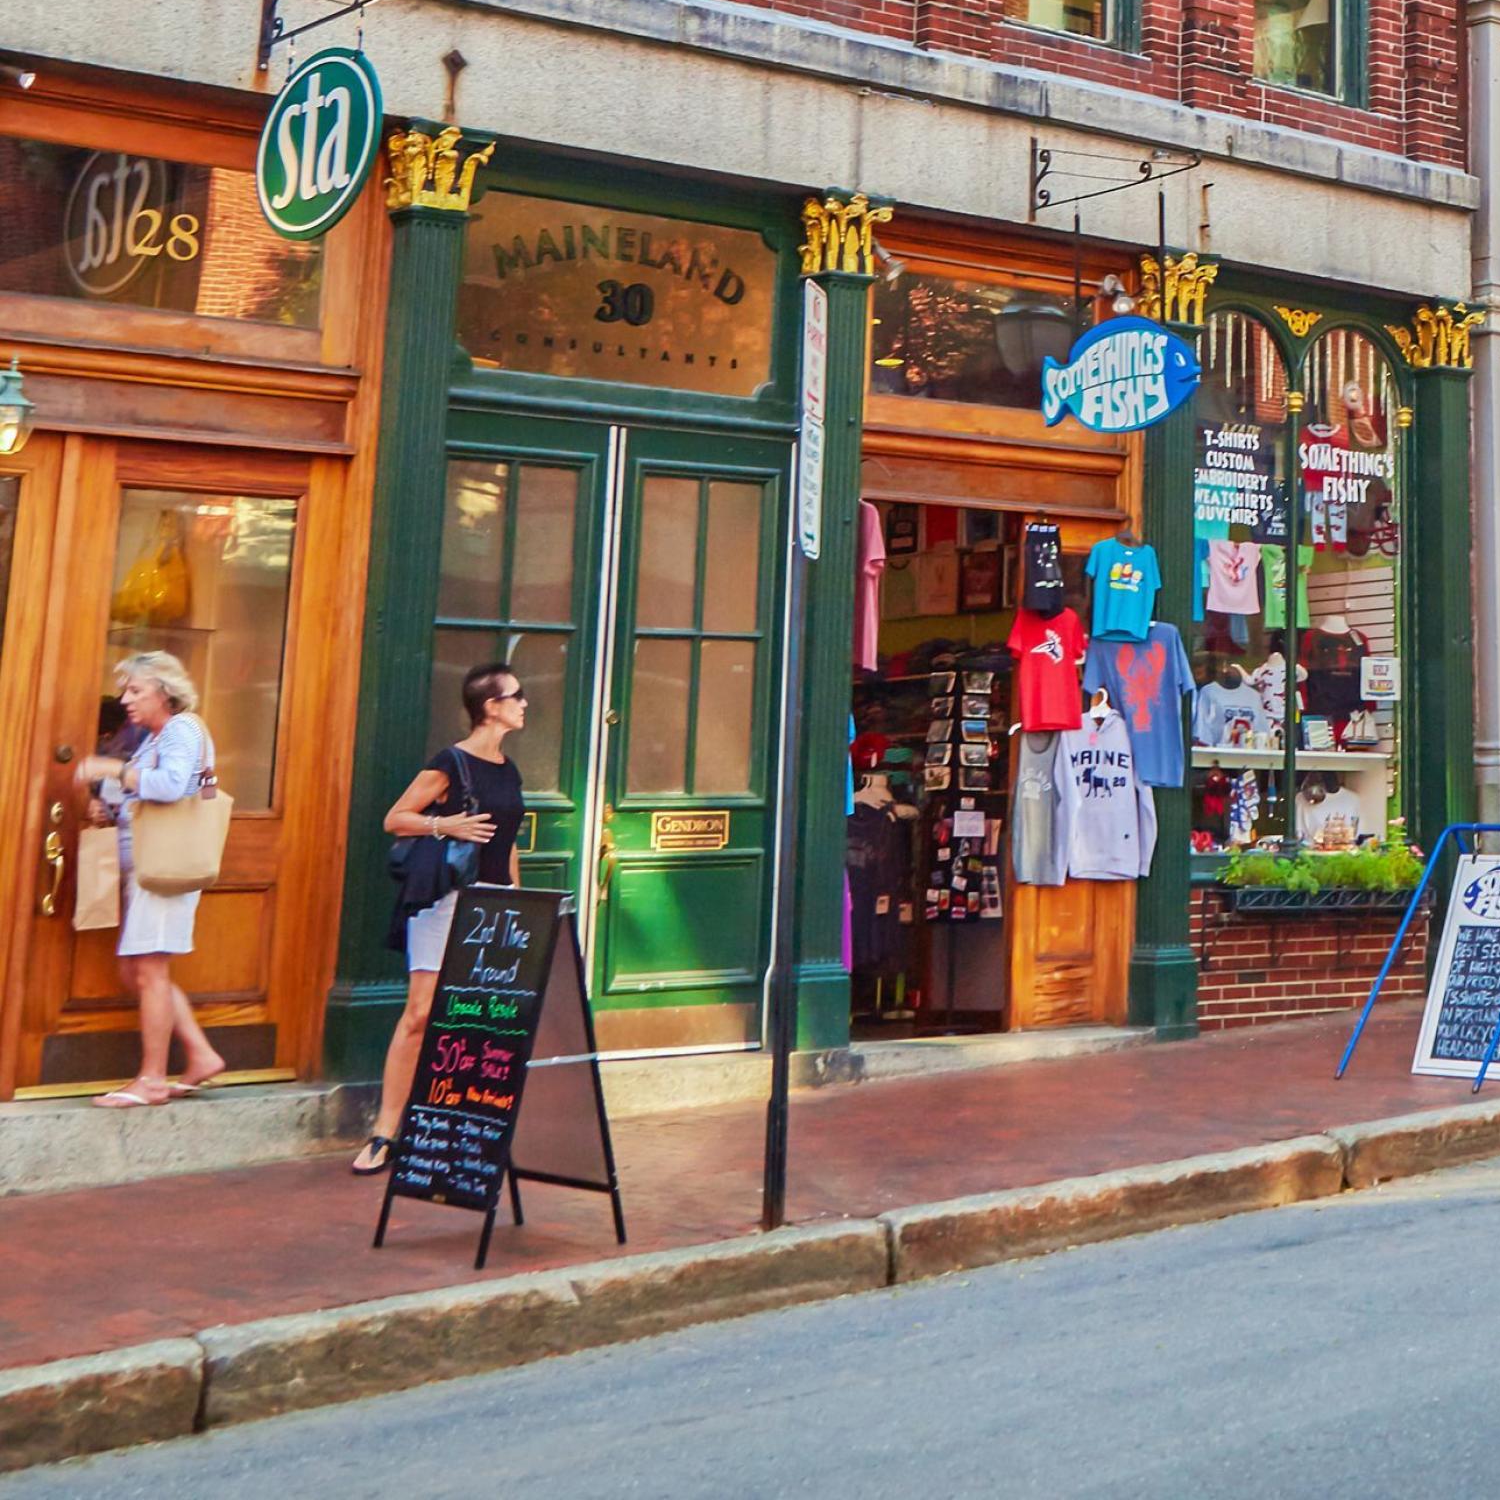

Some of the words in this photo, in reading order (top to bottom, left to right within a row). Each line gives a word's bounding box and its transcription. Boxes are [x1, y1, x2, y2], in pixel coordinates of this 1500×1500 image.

[270, 72, 351, 210] sta
[131, 209, 199, 261] 28
[492, 225, 745, 305] MAINELAND
[594, 279, 654, 326] 30
[491, 330, 738, 369] CONSULTANTS
[1080, 375, 1169, 428] FISHY
[1204, 430, 1260, 451] T-SHIRTS
[1206, 451, 1255, 470] CUSTOM
[1298, 442, 1394, 478] SOMETHING'S
[1194, 488, 1273, 511] WEATSHIRTS
[1323, 477, 1370, 503] FISHY
[1194, 505, 1259, 526] OUVENIRS
[1070, 750, 1130, 769] MAINE
[657, 816, 723, 833] GENDRON
[1458, 929, 1472, 942] WE
[1455, 942, 1479, 958] BEST
[469, 947, 521, 984] Around
[1451, 961, 1466, 974] OF
